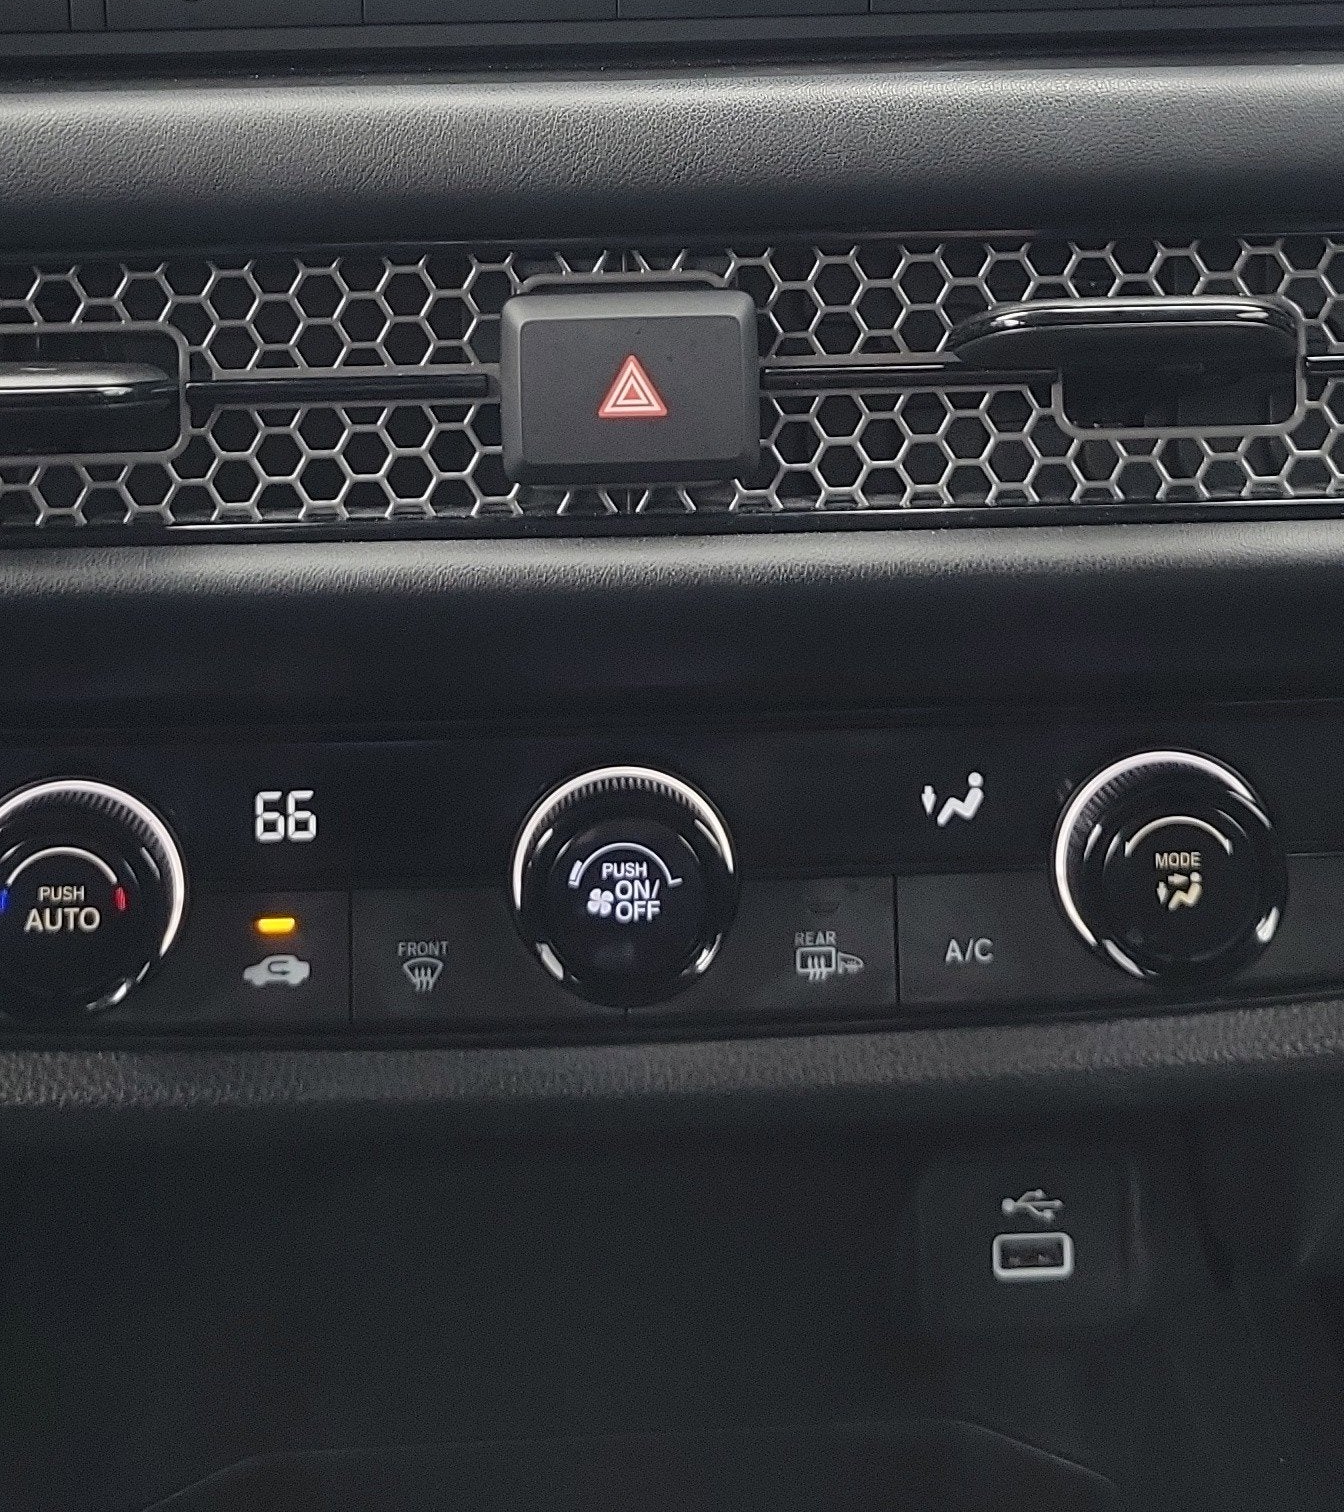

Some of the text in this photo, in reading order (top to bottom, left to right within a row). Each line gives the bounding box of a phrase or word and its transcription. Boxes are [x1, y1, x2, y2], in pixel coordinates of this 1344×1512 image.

[256, 791, 317, 843] 66
[1155, 852, 1201, 869] MODE
[602, 862, 648, 879] PUSH
[38, 886, 85, 903] PUSH
[614, 879, 660, 900] ON/
[24, 907, 101, 933] AUTO
[614, 900, 661, 923] OFF
[795, 931, 836, 946] REAR
[398, 941, 449, 957] FRONT
[945, 939, 994, 963] A/C
